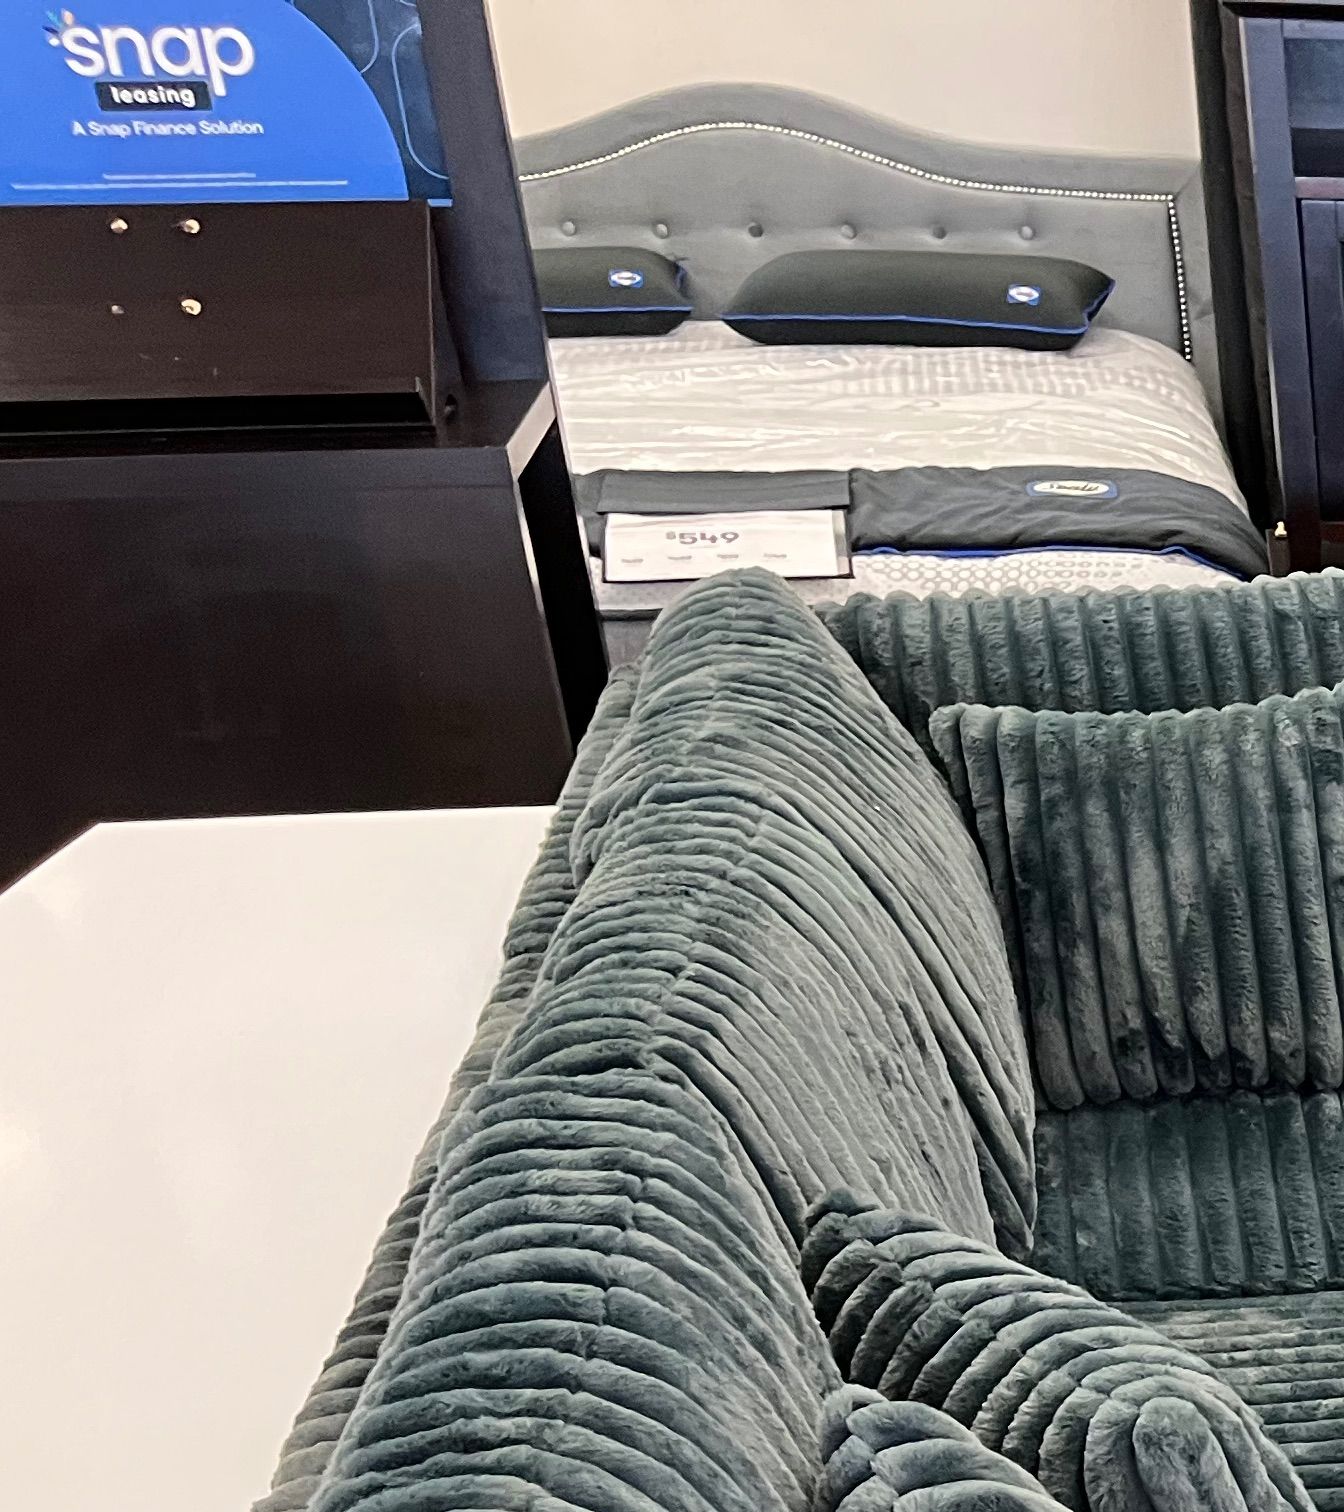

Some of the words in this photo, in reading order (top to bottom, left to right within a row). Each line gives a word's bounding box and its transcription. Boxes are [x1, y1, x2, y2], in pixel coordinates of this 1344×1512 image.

[60, 25, 255, 97] snap
[109, 84, 197, 108] leasing
[72, 121, 86, 136] A
[87, 121, 131, 139] Snap
[132, 120, 197, 136] Finance
[198, 120, 264, 136] Solution
